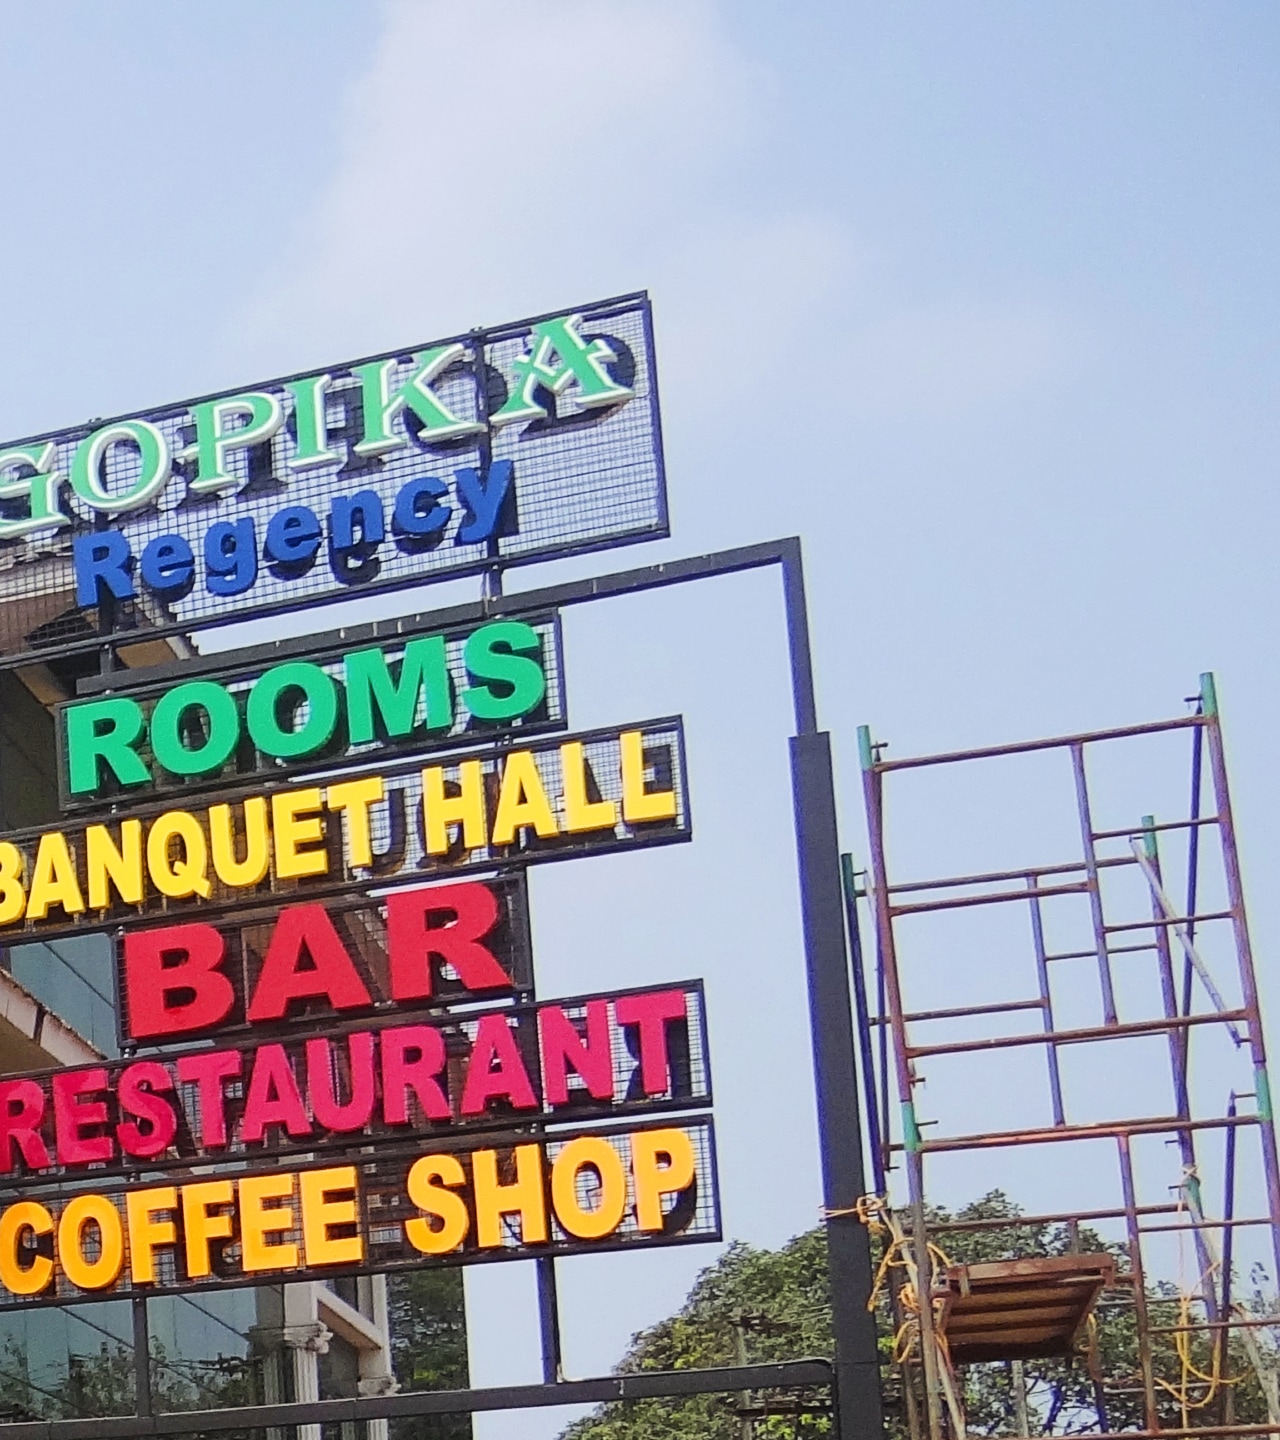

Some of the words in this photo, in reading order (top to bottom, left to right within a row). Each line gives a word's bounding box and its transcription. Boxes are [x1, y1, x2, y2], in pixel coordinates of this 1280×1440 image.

[73, 459, 514, 608] Regency
[63, 619, 546, 795] ROOMS
[423, 730, 678, 856] HALL
[124, 881, 514, 1038] BAR
[404, 1127, 696, 1256] SHOP
